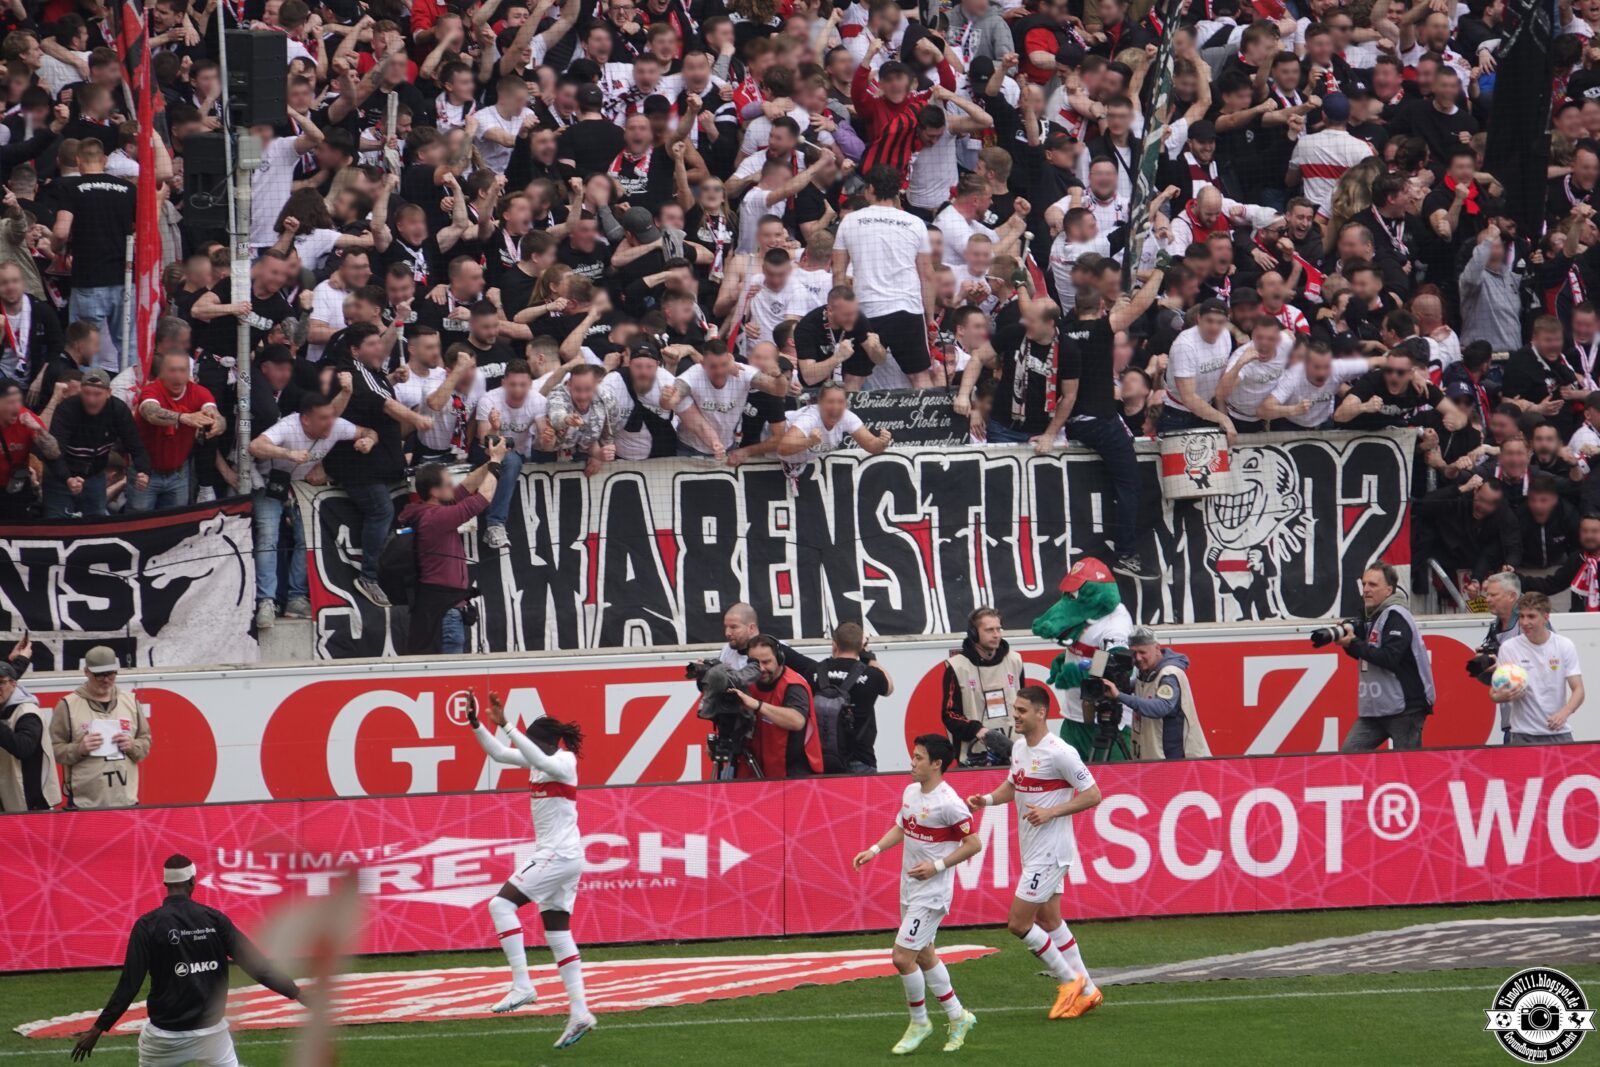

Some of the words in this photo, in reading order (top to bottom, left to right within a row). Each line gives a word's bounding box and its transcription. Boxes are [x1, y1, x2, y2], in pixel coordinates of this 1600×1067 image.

[854, 391, 898, 409] Brüder
[898, 389, 924, 407] seid
[875, 420, 906, 431] euren
[906, 409, 939, 429] Stolz
[940, 414, 952, 427] in
[308, 450, 1208, 660] SWABENSTURM
[103, 770, 127, 787] TV
[954, 780, 1420, 892] MSCOT®
[217, 841, 404, 871] ULTIMATE
[521, 860, 536, 875] 7
[575, 877, 677, 892] ORKWEAR
[1030, 873, 1041, 890] 5
[909, 918, 921, 937] 3
[190, 961, 218, 974] JAKO
